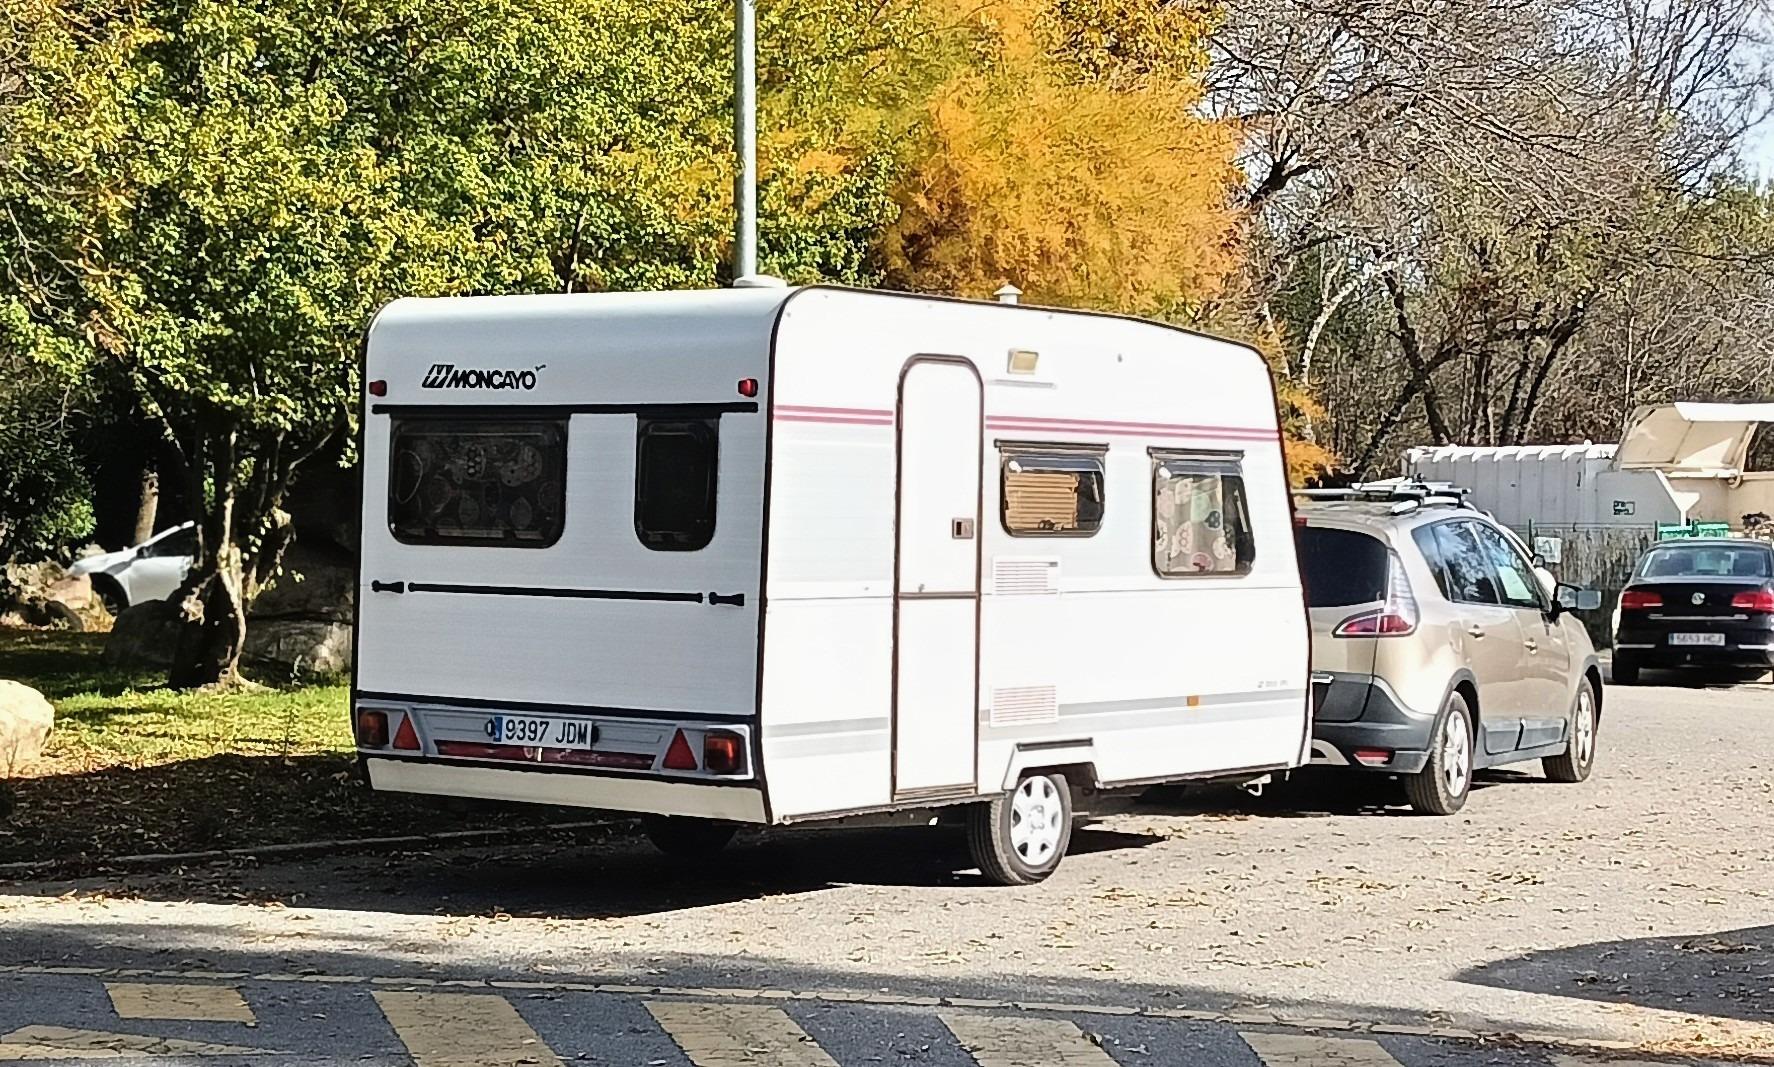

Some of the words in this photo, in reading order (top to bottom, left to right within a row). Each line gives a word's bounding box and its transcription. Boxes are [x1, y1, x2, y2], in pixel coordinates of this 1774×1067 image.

[446, 369, 537, 390] MONCAYO
[505, 719, 550, 742] 9397
[555, 721, 588, 745] JDM
